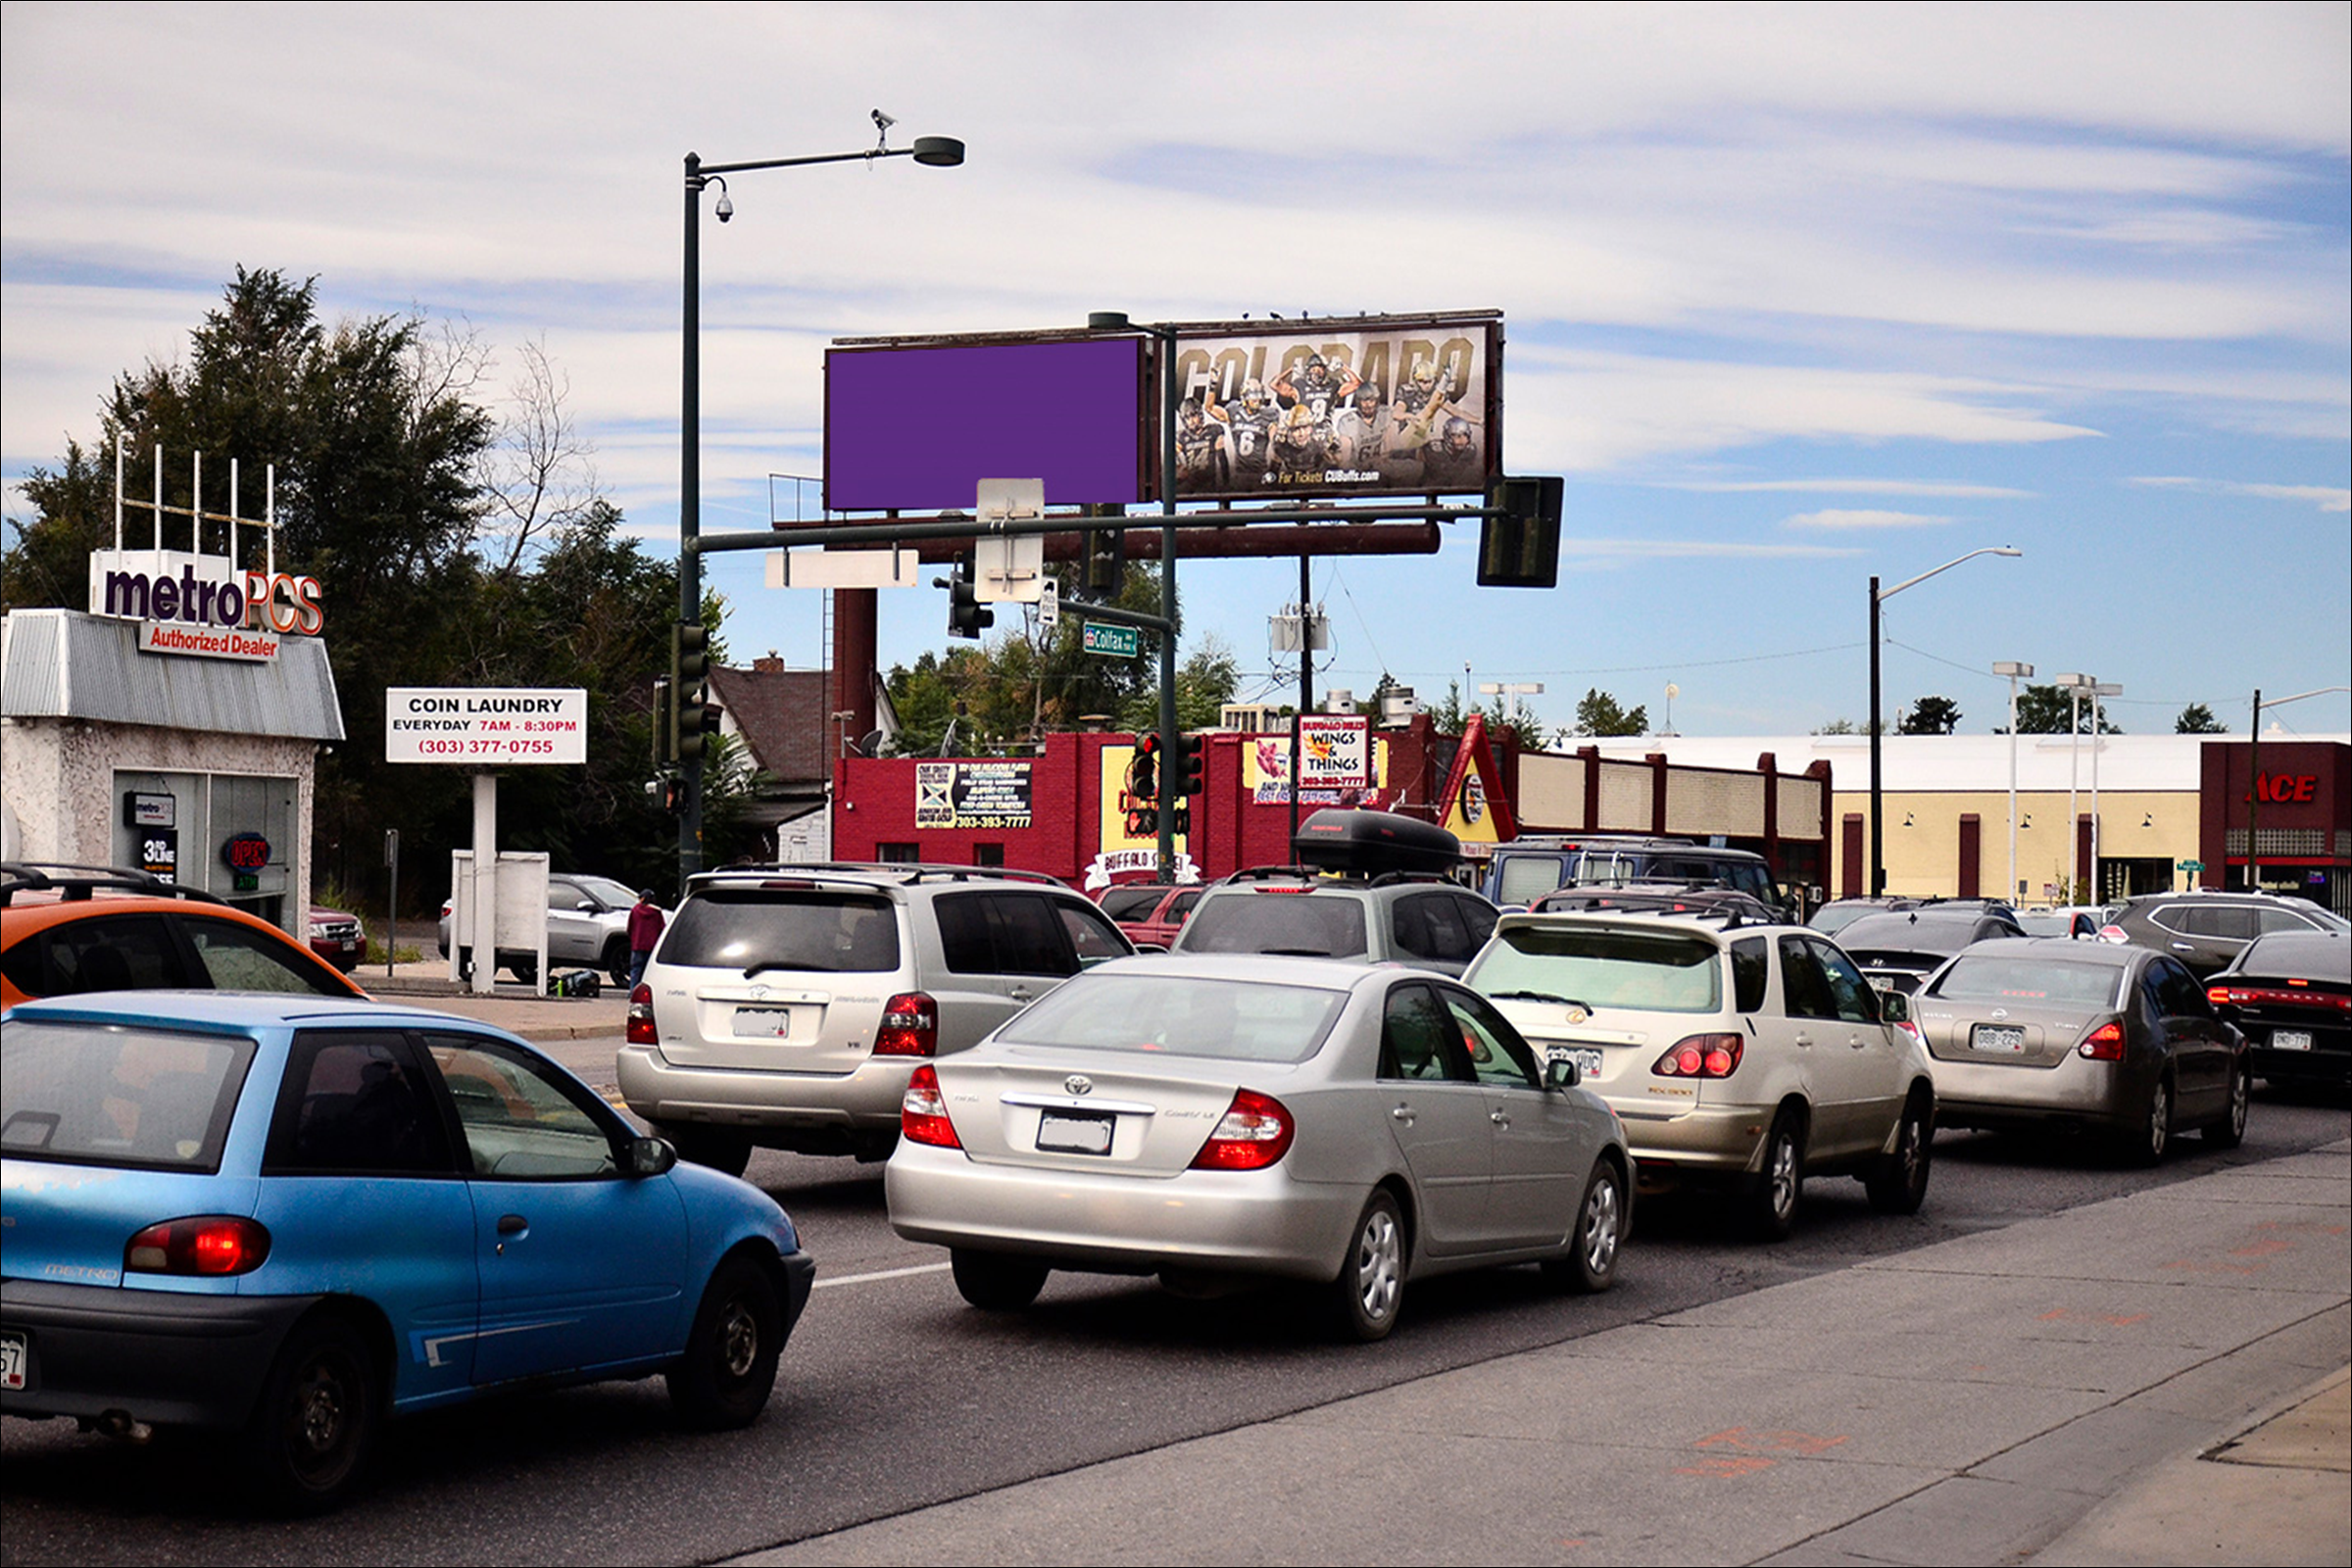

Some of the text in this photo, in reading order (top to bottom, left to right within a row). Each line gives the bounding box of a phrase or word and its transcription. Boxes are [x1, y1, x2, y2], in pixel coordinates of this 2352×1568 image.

[1239, 431, 1255, 456] 6
[1278, 470, 1294, 484] For
[1295, 470, 1323, 484] Tickets
[105, 564, 323, 635] metroPCS
[150, 626, 277, 658] Authorized Dealer
[1095, 630, 1123, 651] Colfax
[409, 698, 564, 713] COIN LAUNDRY
[393, 719, 471, 731] EVERYDAY
[479, 720, 512, 732] 7AM
[523, 720, 577, 732] 8:30PM
[1310, 731, 1356, 745] WINGS
[418, 740, 554, 754] (303) 377-0755
[1327, 745, 1338, 758] &
[1307, 758, 1359, 771] THINGS
[2244, 770, 2318, 803] ACE
[956, 816, 1031, 828] 303-393-7777
[230, 840, 267, 866] OPEN
[1104, 852, 1149, 871] BUFFALO
[45, 1263, 120, 1281] METRO
